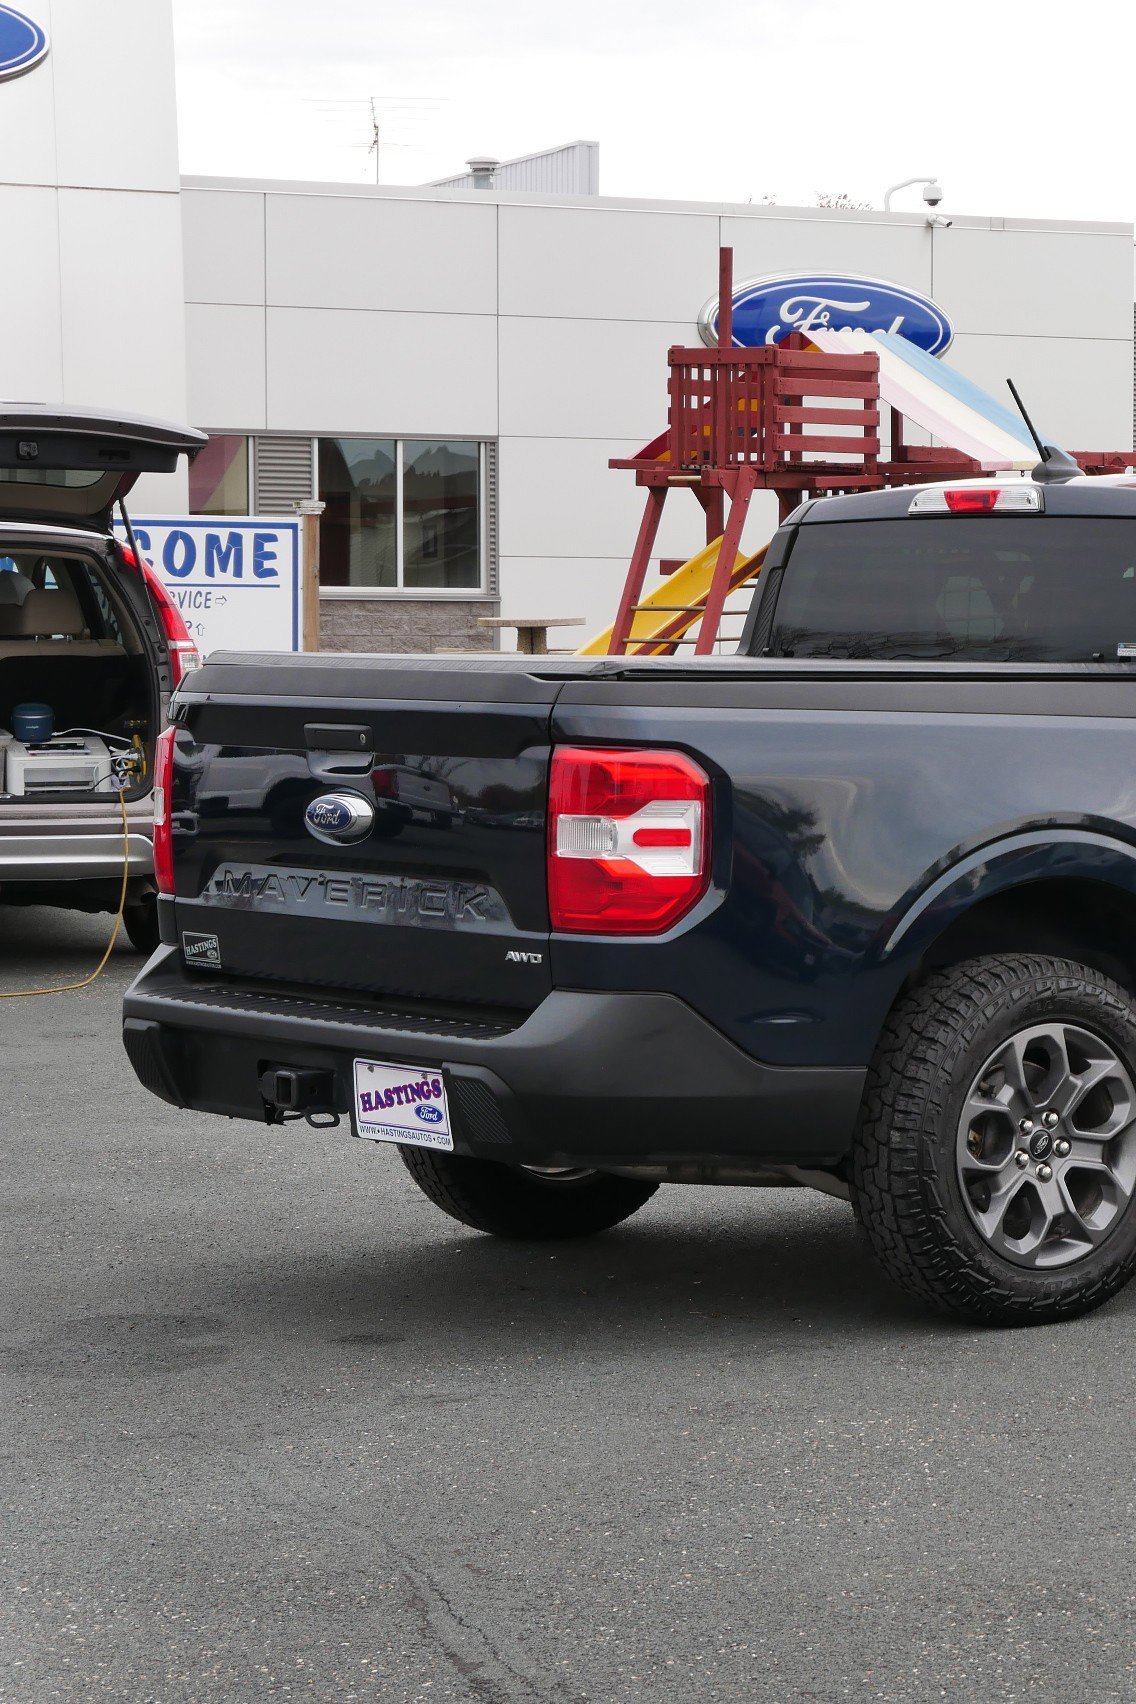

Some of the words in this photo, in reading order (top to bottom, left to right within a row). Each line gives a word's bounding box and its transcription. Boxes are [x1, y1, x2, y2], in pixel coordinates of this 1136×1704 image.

[765, 296, 904, 345] Fd
[313, 803, 341, 825] Ford
[221, 869, 488, 921] MAVERICK
[186, 939, 217, 956] HASTINGS
[505, 951, 542, 963] AWD
[360, 1078, 443, 1113] HASTINGS
[419, 1106, 439, 1121] Ford
